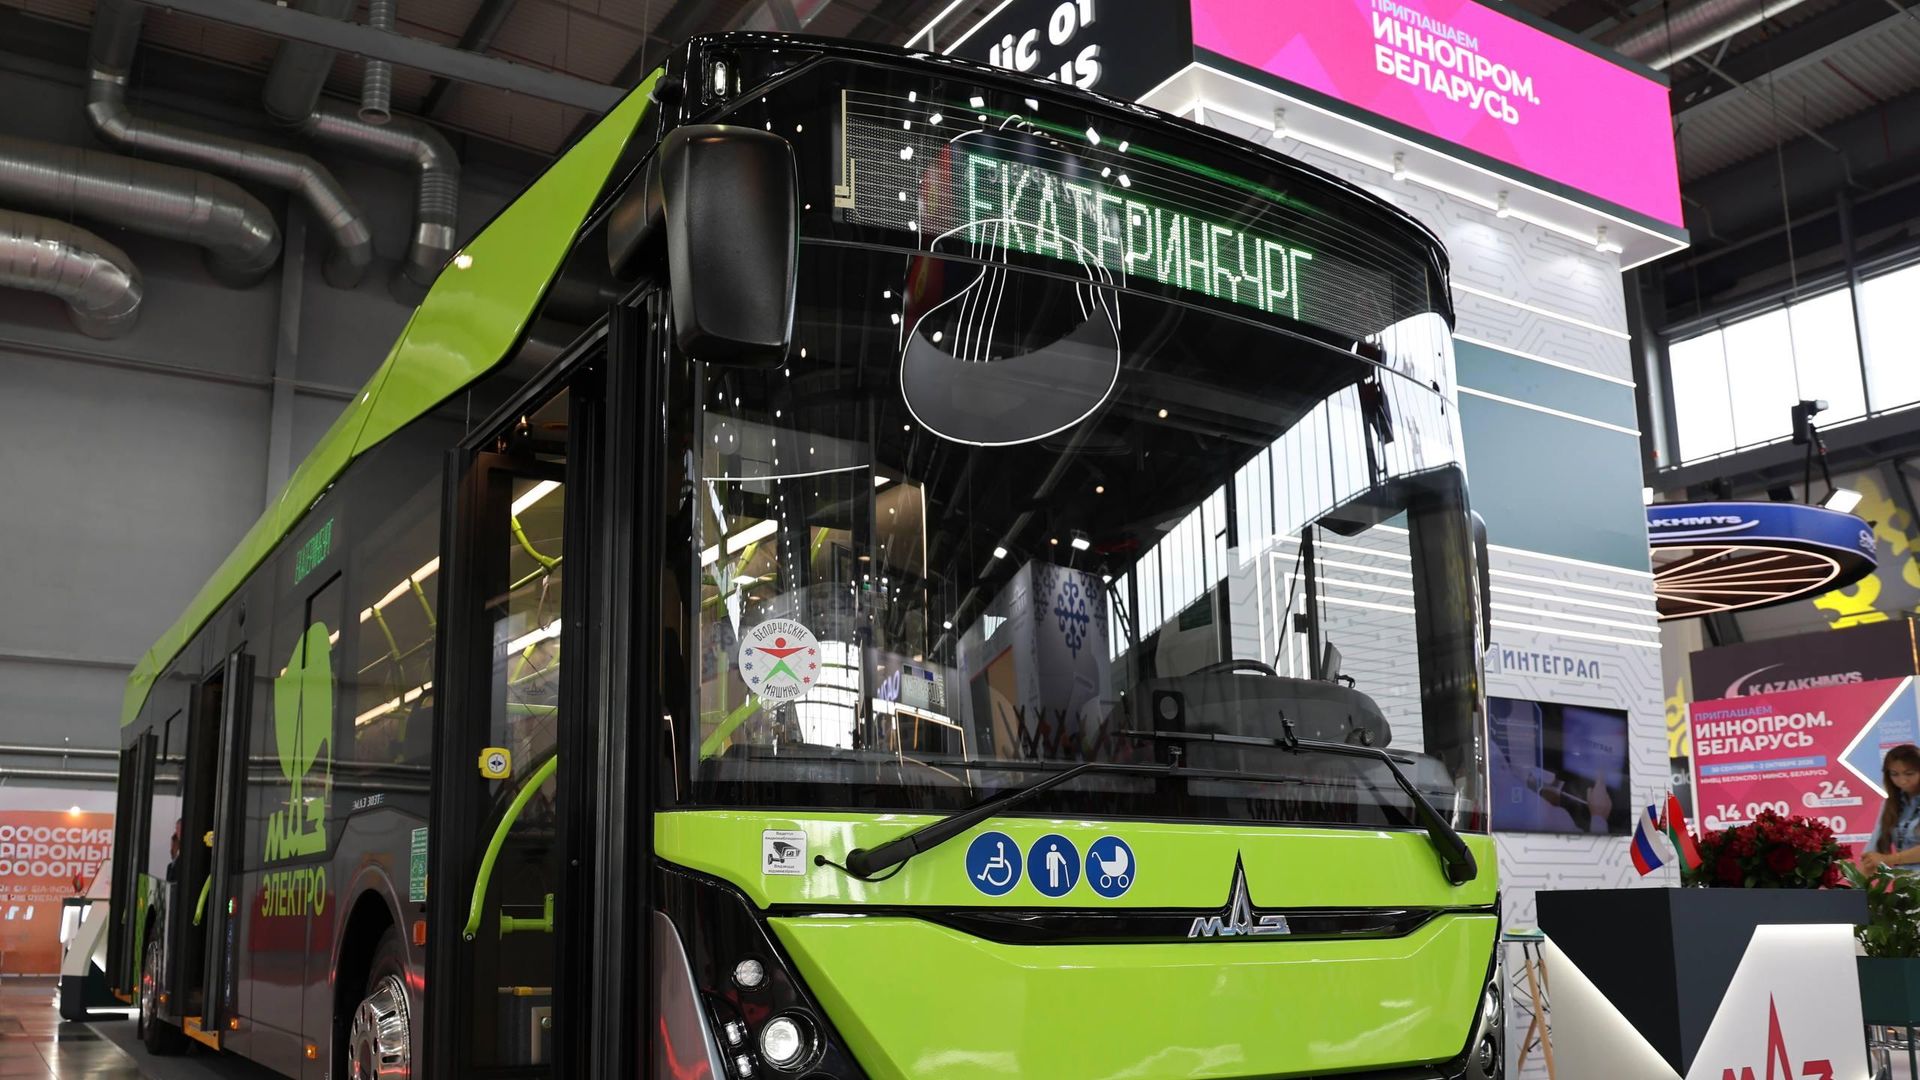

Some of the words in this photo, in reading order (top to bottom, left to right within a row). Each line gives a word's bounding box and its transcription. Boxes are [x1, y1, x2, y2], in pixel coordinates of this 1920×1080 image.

[1371, 0, 1479, 52] ПРИГЛАШАЕМ
[1371, 12, 1541, 106] ИННОПРОМ.
[1375, 43, 1520, 125] БЕЛАРУСЬ
[752, 621, 808, 642] БЕЛОРУССКИЕ
[1502, 649, 1601, 680] ИНТЕГРАЛ
[763, 683, 800, 698] МАШИНЫ
[1748, 671, 1863, 697] KAZAKHMYS
[1694, 705, 1773, 721] ПРИГЛАШАЕМ
[1695, 710, 1834, 740] ИННОПРОМ.
[1697, 731, 1814, 757] БЕЛАРУСЬ
[1818, 780, 1851, 799] 24
[1716, 803, 1742, 821] 14
[262, 865, 327, 917] ЭЛЕКТРО
[1187, 868, 1292, 938] МАЗ
